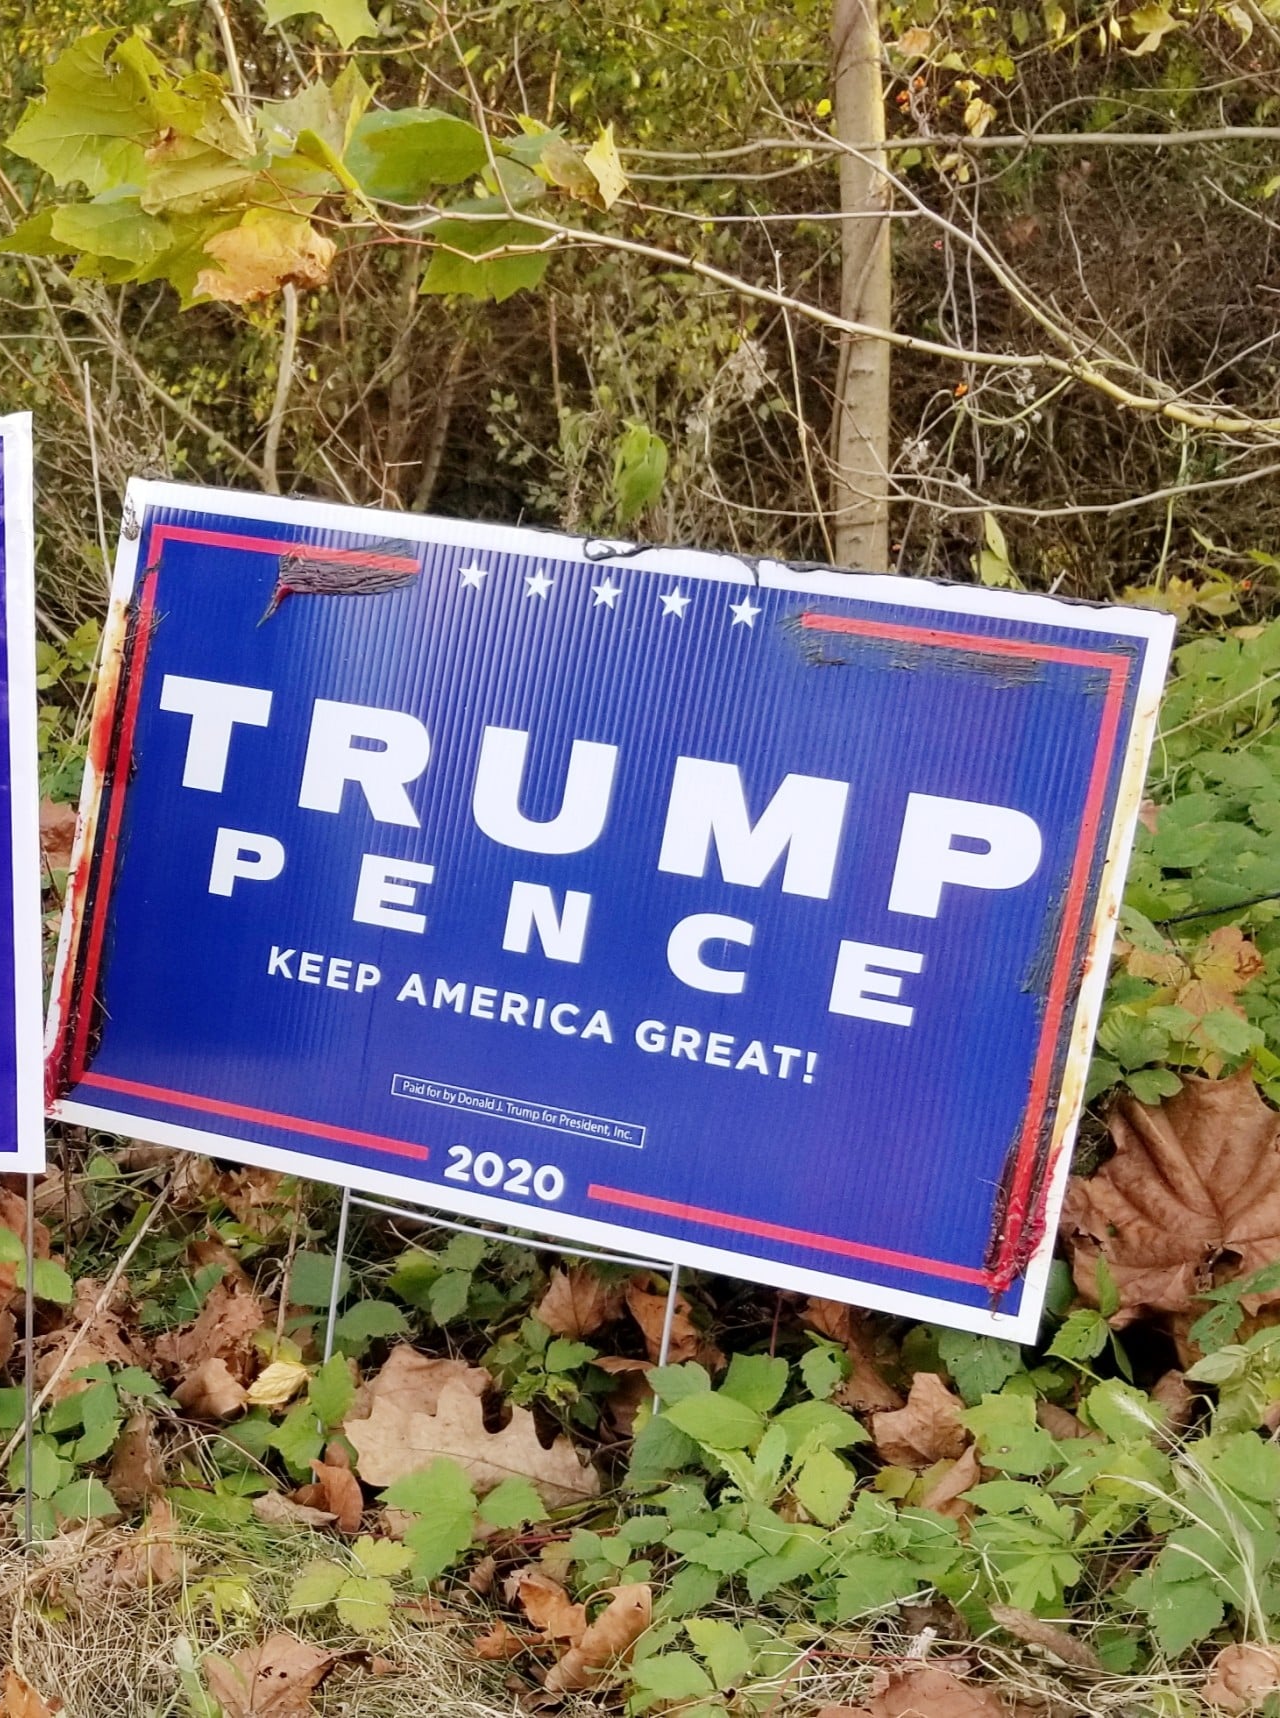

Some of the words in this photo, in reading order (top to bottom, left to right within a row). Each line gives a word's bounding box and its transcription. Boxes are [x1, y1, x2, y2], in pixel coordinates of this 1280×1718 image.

[160, 675, 1043, 919] TRUMP
[209, 828, 925, 1027] PENCE
[267, 945, 381, 993] KEEP
[396, 973, 613, 1044] AMERICA
[635, 1019, 818, 1084] GREAT!
[402, 1080, 425, 1095] Paid
[426, 1085, 441, 1098] for
[443, 1088, 456, 1104] by
[457, 1092, 495, 1110] Donald
[495, 1101, 504, 1112] J.
[506, 1102, 540, 1120] Trump
[541, 1110, 557, 1124] for
[559, 1114, 611, 1136] President,
[613, 1126, 633, 1140] Inc.
[443, 1145, 565, 1202] 2020
